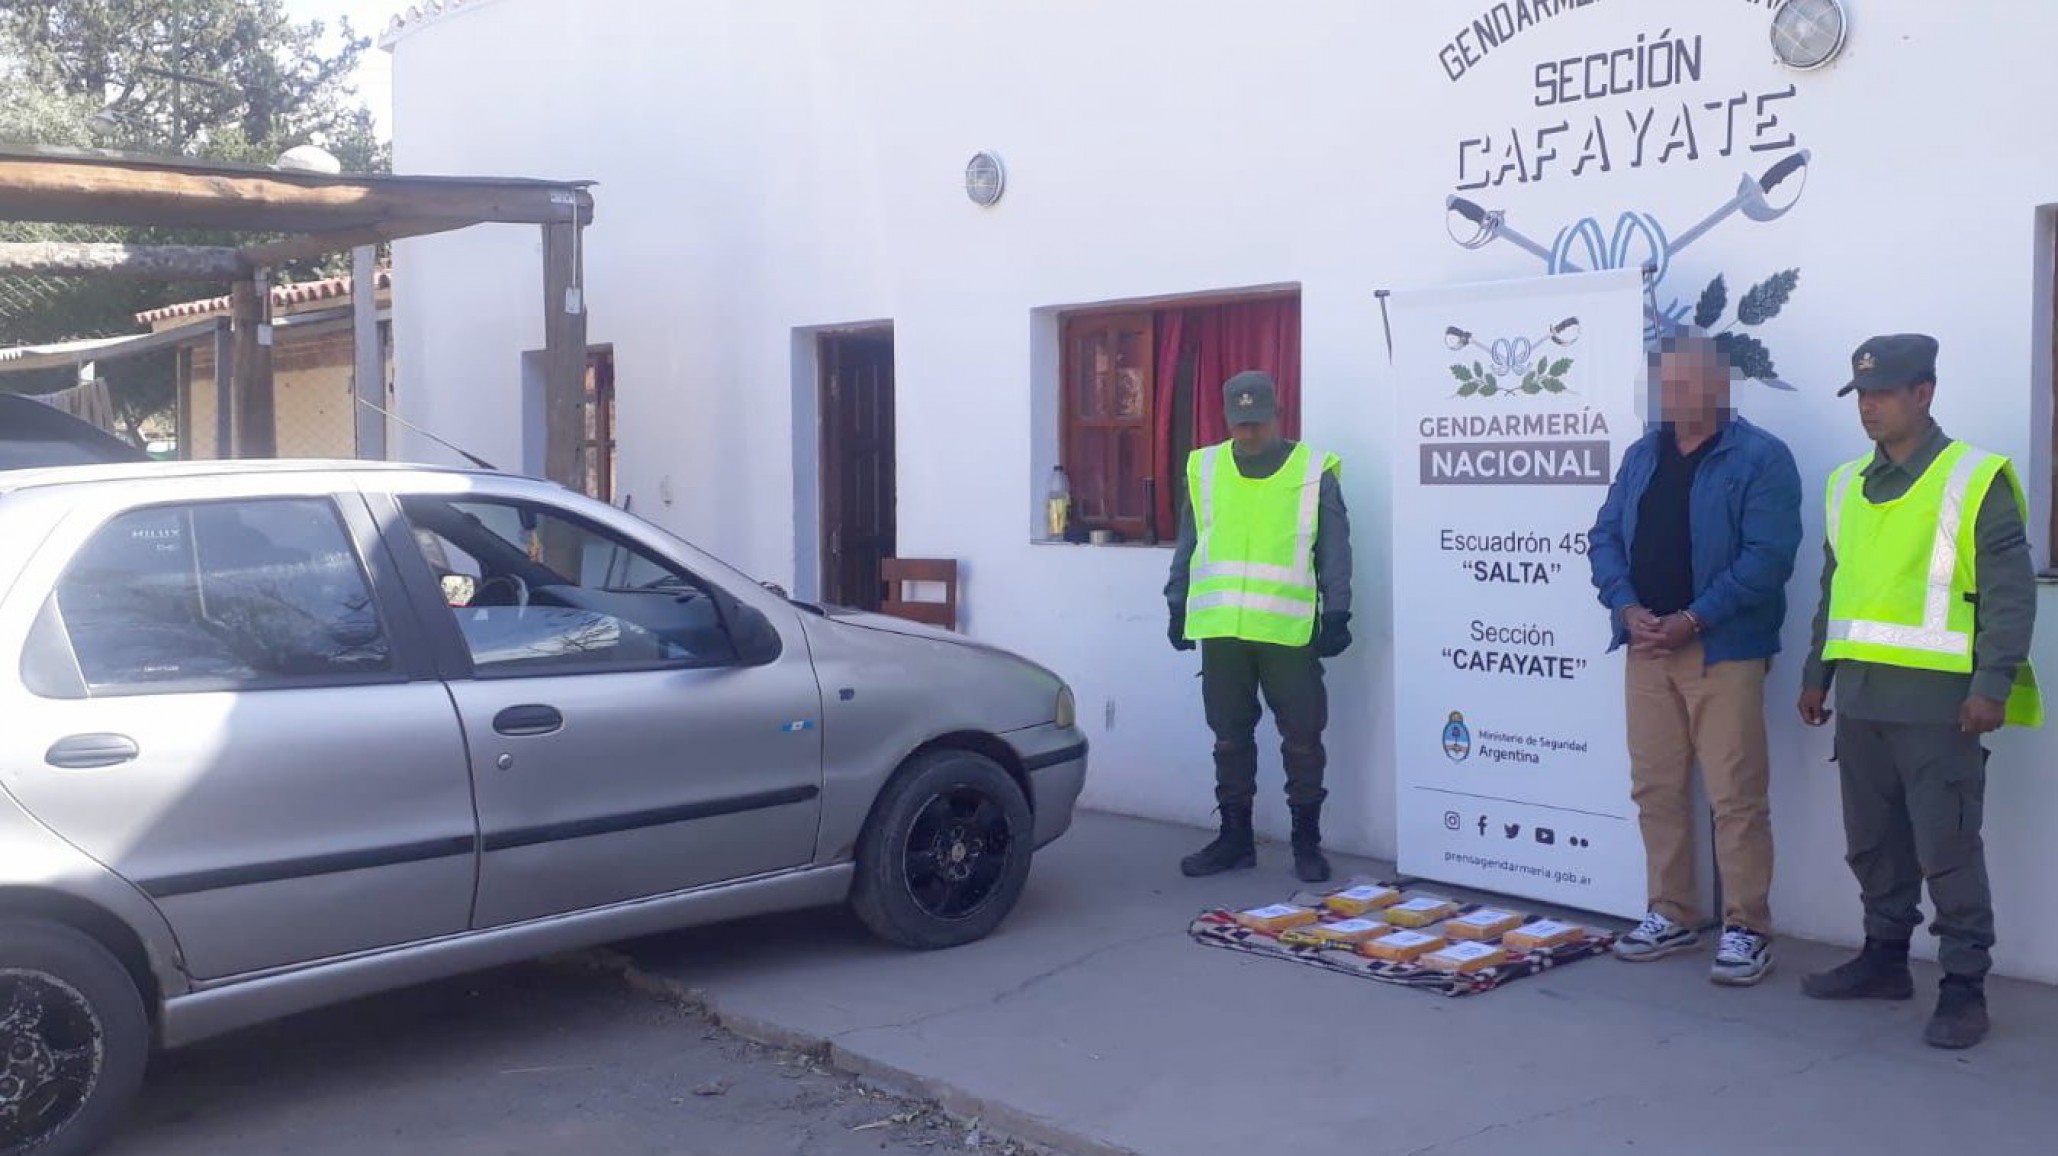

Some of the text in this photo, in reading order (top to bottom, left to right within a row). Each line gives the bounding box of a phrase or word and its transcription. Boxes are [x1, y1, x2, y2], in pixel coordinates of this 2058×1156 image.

[1439, 0, 1600, 82] GENDAR
[1456, 83, 1797, 190] CAFAYATE
[1420, 406, 1608, 437] GENDARMERÍA
[1431, 449, 1600, 477] NACIONAL
[1441, 529, 1587, 555] Escuadrón 45
[1462, 560, 1561, 585] “SALTA”
[1470, 619, 1554, 646] Sección
[1442, 648, 1587, 680] “CAFAYATE”
[1479, 730, 1587, 753] Ministerio de Seguridad
[1479, 744, 1540, 764] Argentina
